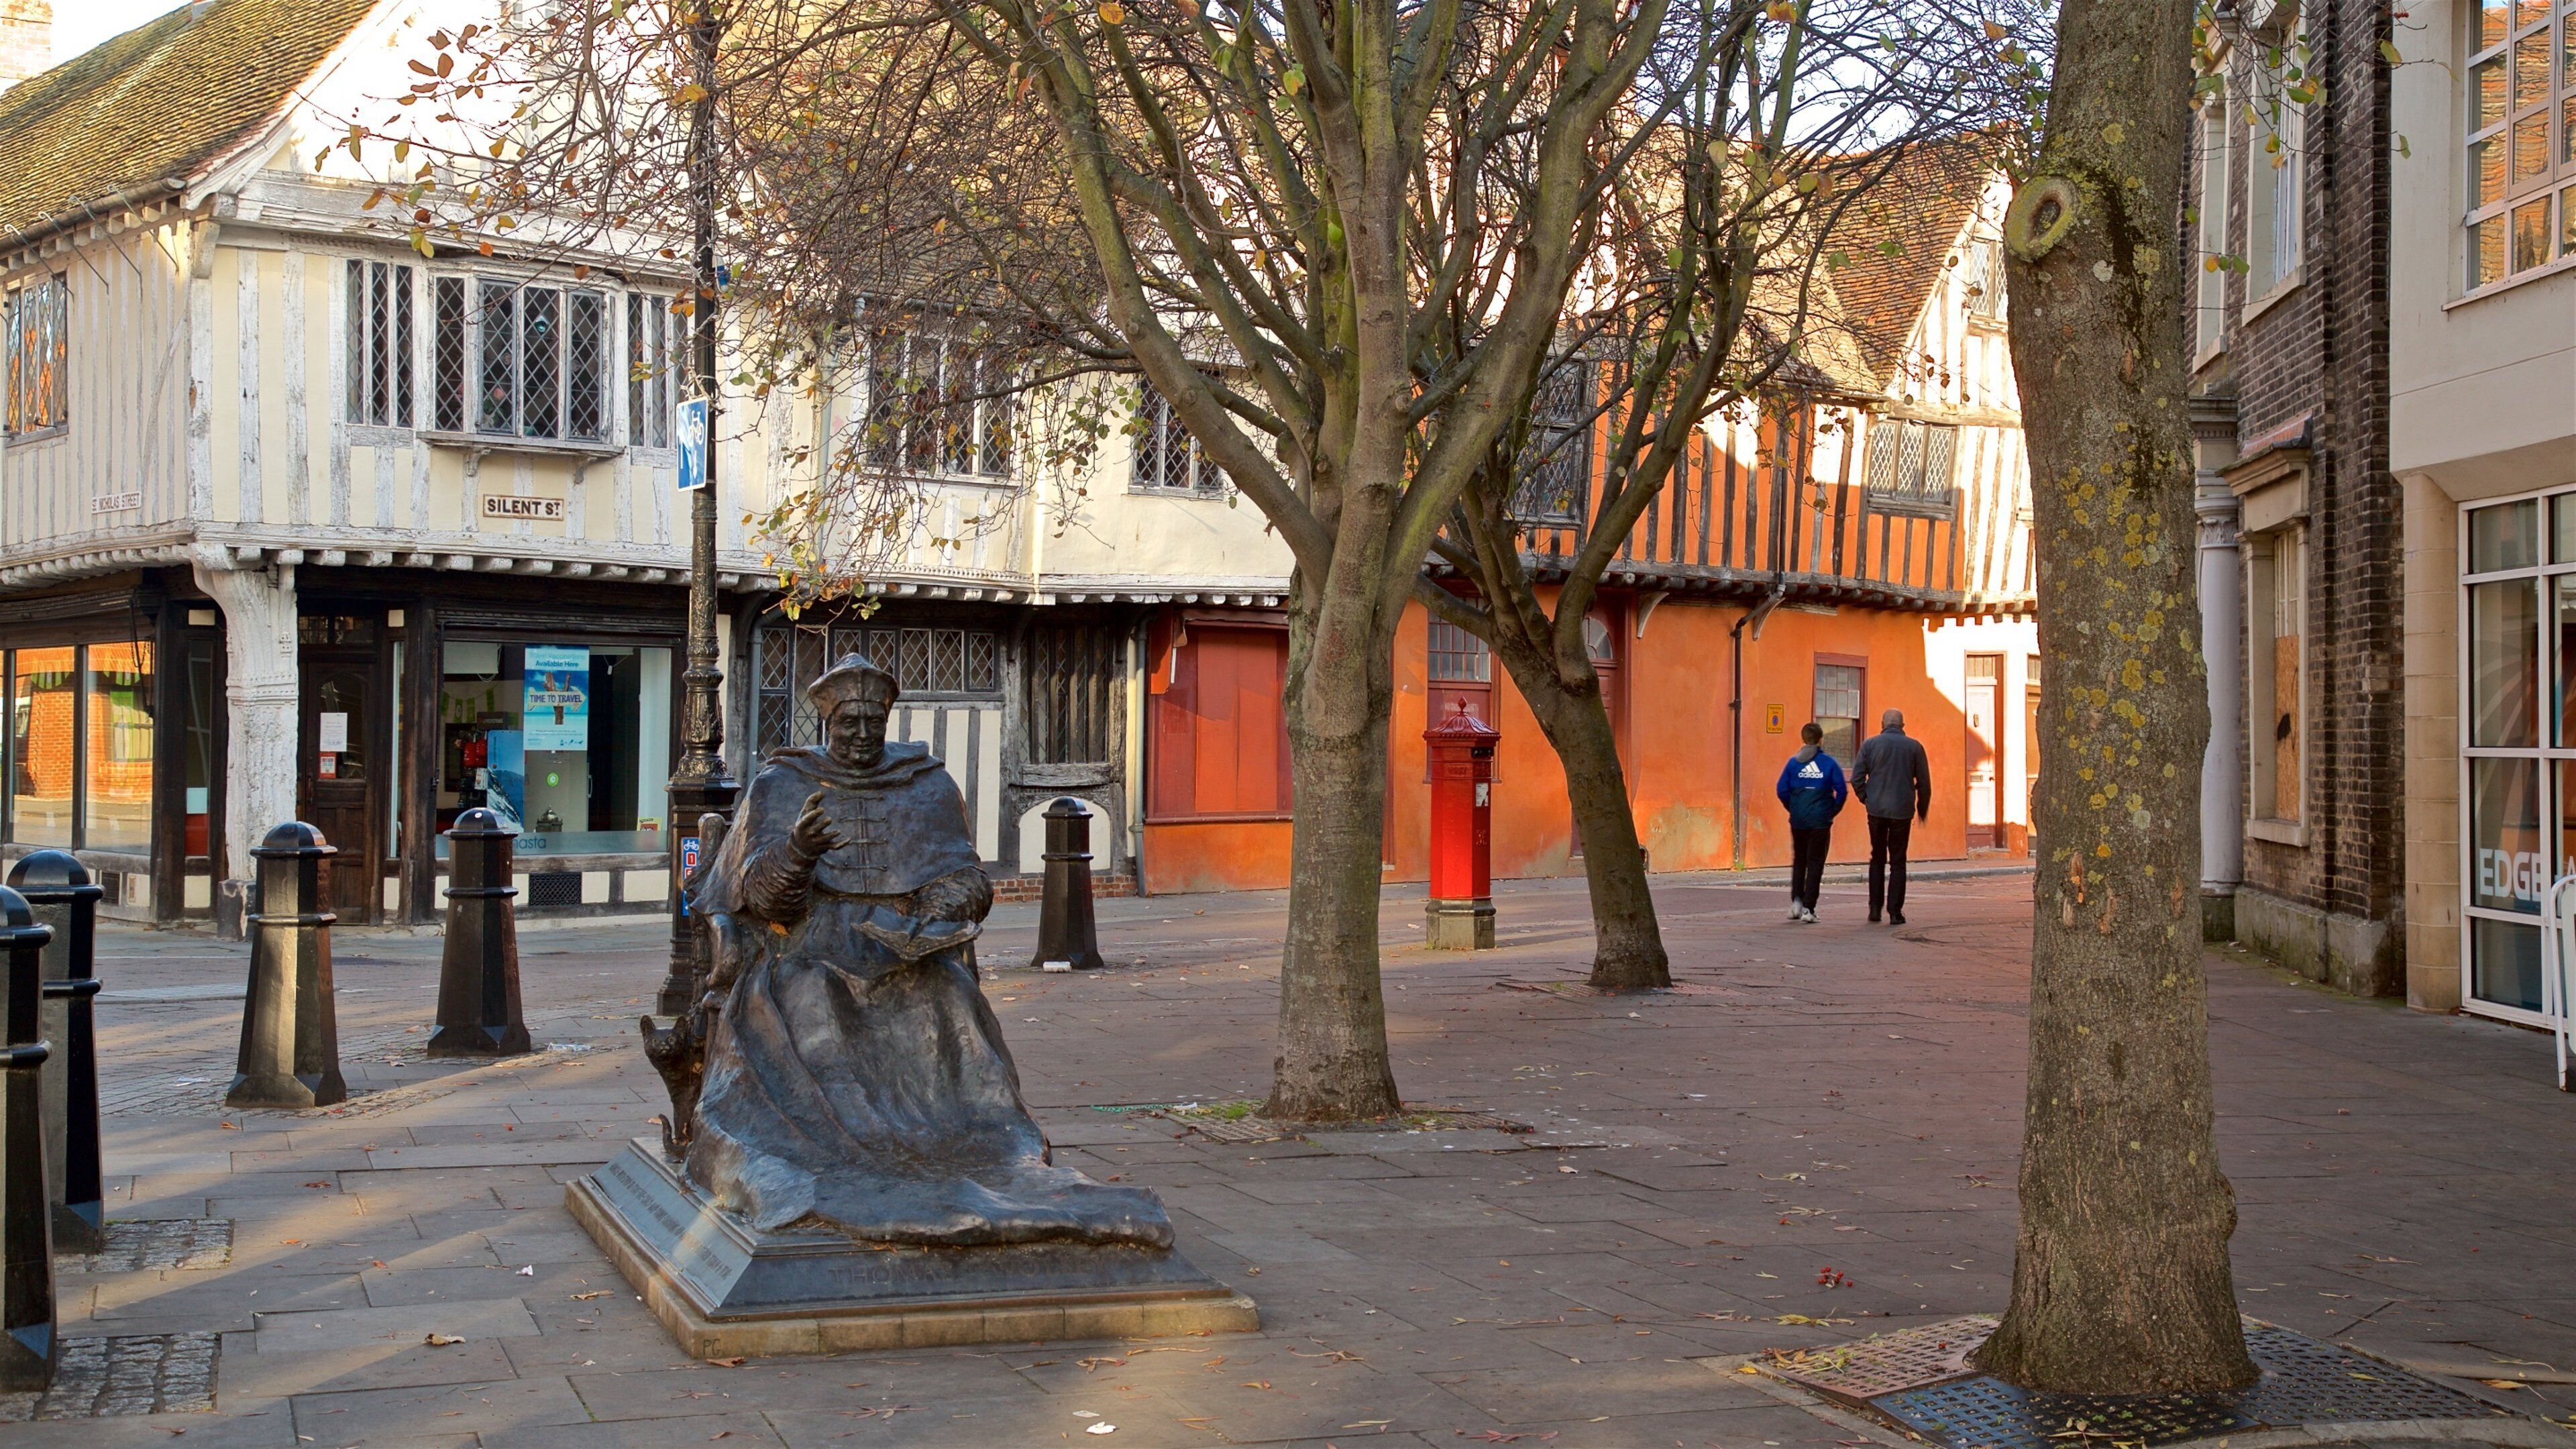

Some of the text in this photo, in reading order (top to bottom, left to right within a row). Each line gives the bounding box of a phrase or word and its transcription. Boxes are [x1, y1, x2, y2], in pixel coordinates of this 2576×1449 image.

[122, 492, 140, 507] STREET
[487, 498, 541, 515] SILENT
[529, 694, 582, 703] TIME TO TRAVEL
[690, 855, 693, 863] 1
[2479, 848, 2541, 902] EDGE
[703, 1338, 722, 1356] PG
